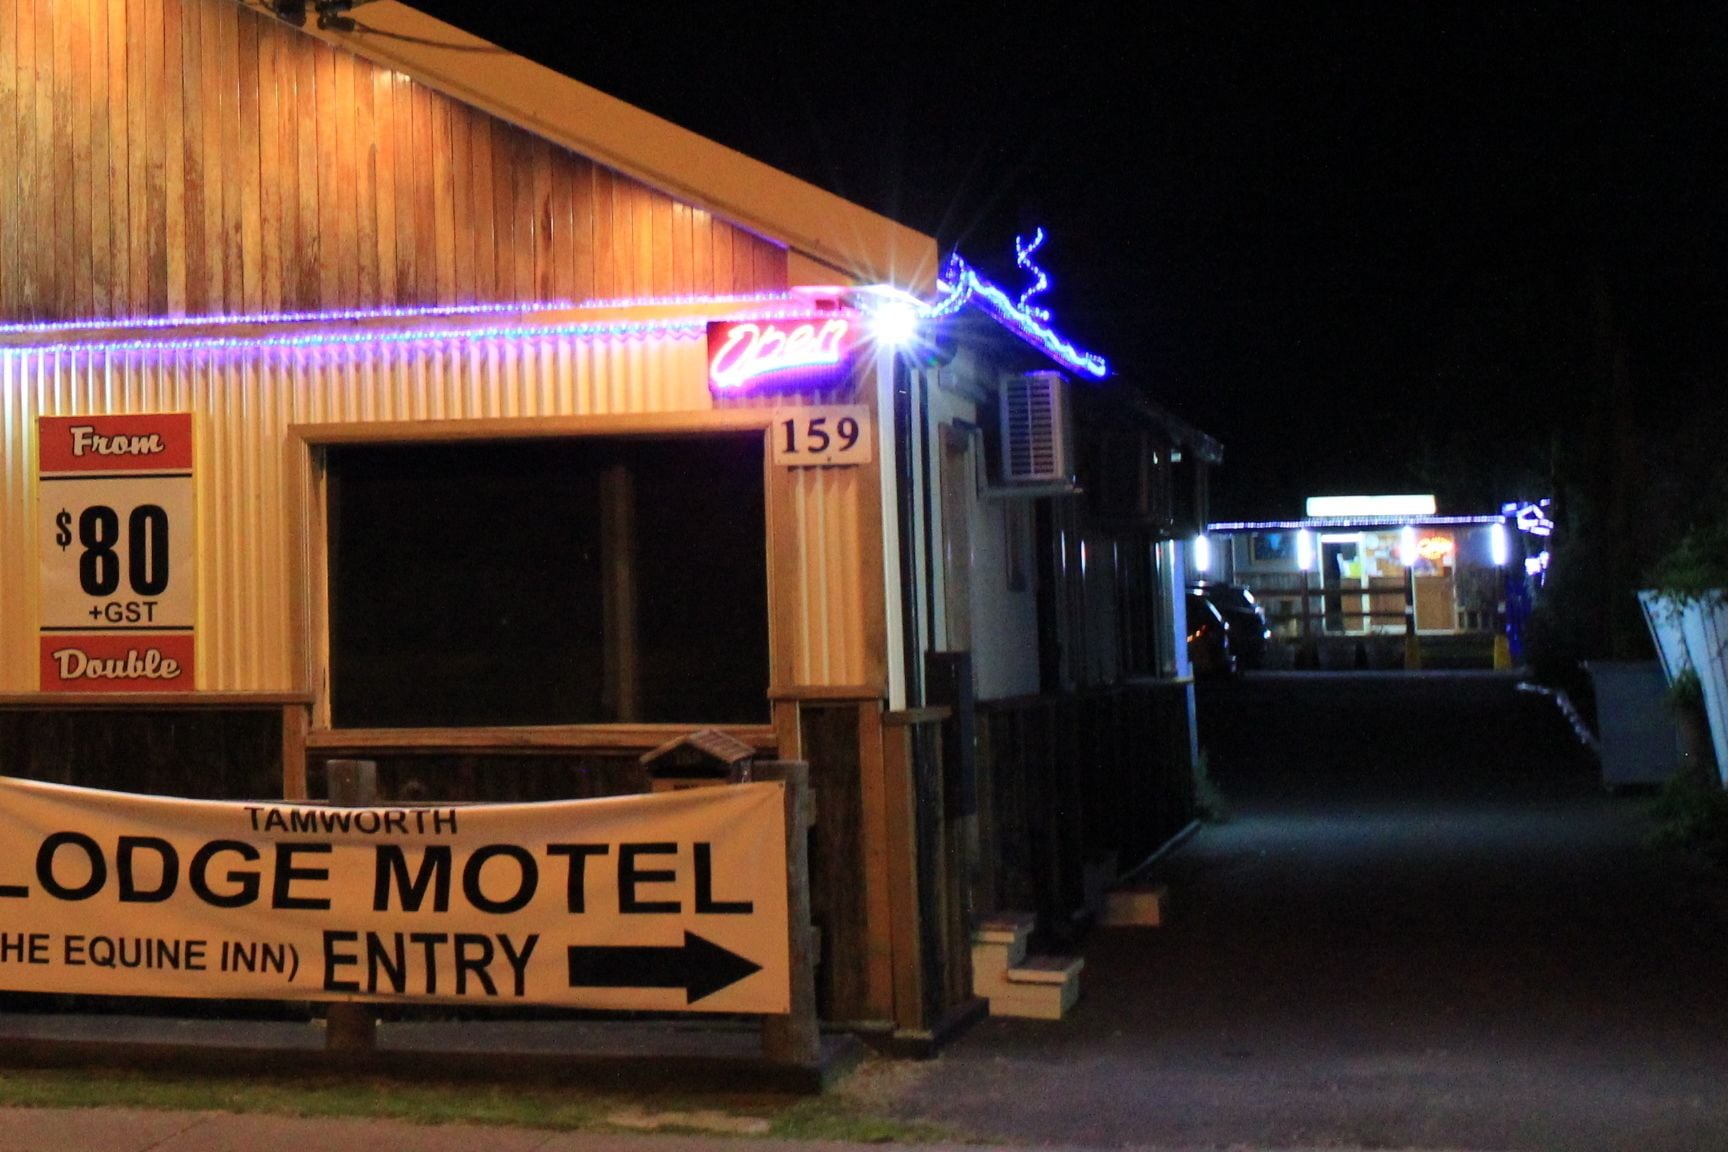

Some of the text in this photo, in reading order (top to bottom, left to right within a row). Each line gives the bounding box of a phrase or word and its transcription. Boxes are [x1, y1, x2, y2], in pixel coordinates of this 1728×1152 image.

[709, 319, 848, 387] Open
[70, 425, 165, 456] From
[782, 416, 860, 454] 159
[55, 504, 170, 596] $80
[88, 601, 158, 623] +GST
[52, 648, 181, 679] Double
[244, 806, 459, 835] TAMWORTH
[373, 841, 754, 915] MOTEL
[64, 934, 207, 970] EQUINE
[220, 941, 299, 982] INN)
[322, 930, 540, 997] ENTRY
